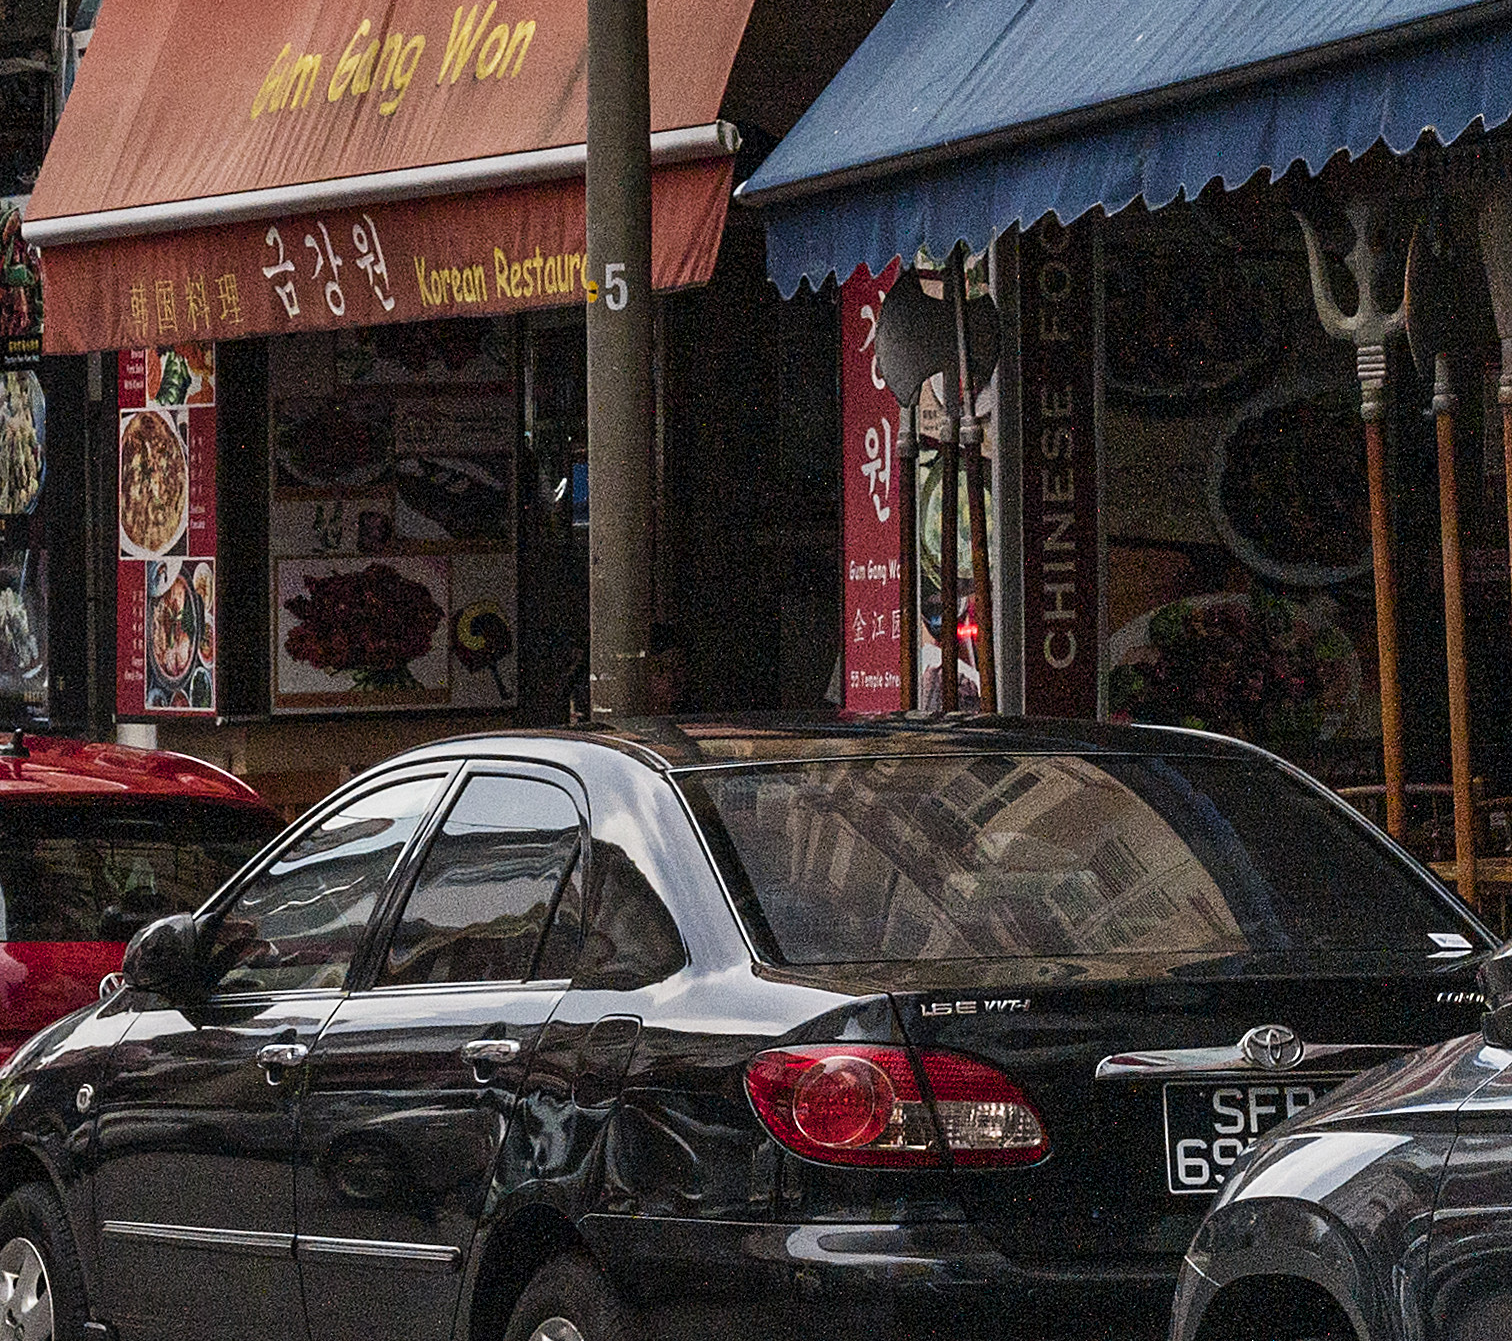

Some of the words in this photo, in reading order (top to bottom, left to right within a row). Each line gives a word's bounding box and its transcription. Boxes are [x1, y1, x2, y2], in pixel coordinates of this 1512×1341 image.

[252, 44, 319, 118] Gum
[330, 21, 425, 116] Gang
[436, 0, 535, 86] Won
[263, 216, 394, 318] 금강원
[414, 255, 488, 306] Korean
[605, 264, 628, 311] 5
[1039, 221, 1073, 342] FOO
[1040, 386, 1077, 670] CHINESE
[849, 559, 866, 581] Gum
[867, 560, 888, 584] Gang
[860, 669, 883, 690] Temple
[884, 670, 901, 689] Stre
